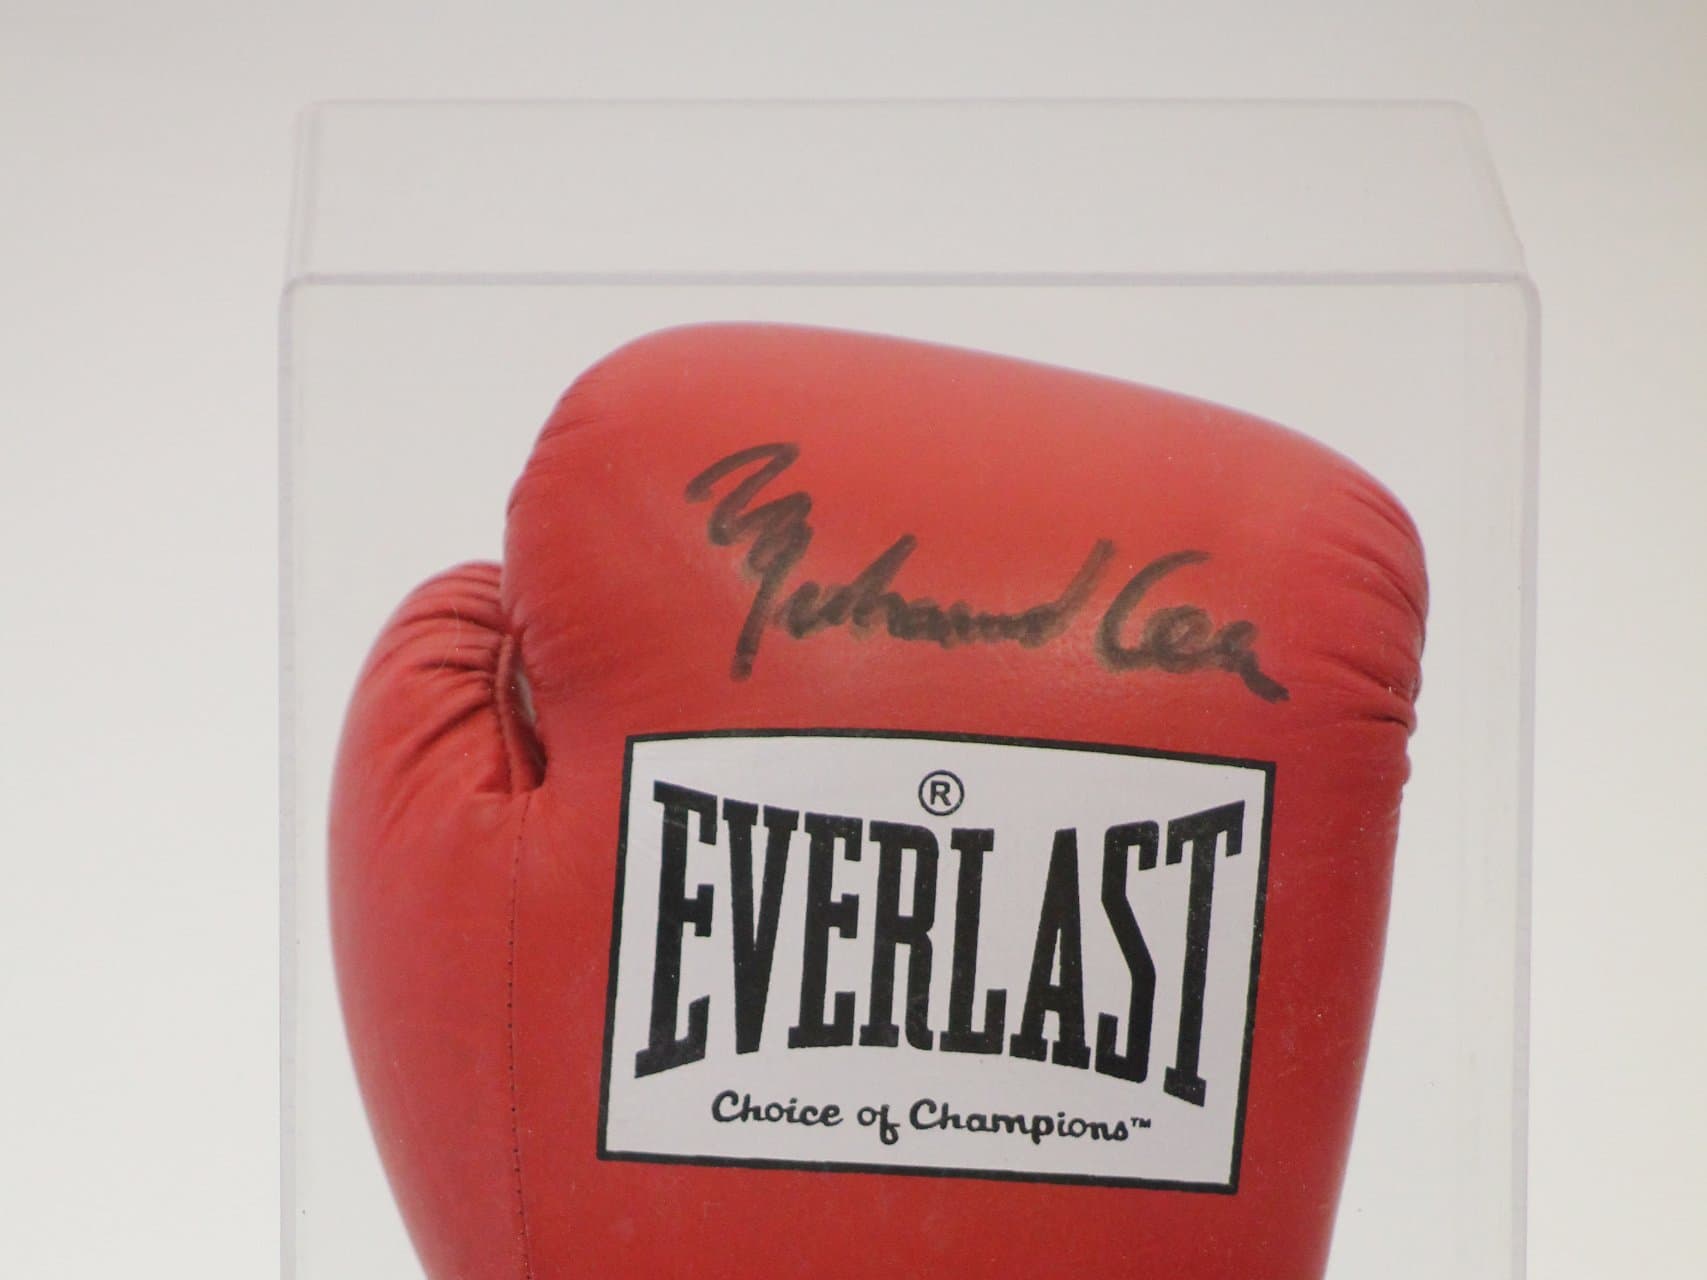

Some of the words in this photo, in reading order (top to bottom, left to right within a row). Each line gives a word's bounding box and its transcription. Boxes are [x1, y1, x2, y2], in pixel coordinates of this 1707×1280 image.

[635, 780, 1245, 1107] EVERLAST
[711, 1089, 843, 1126] Choice
[857, 1104, 900, 1145] of
